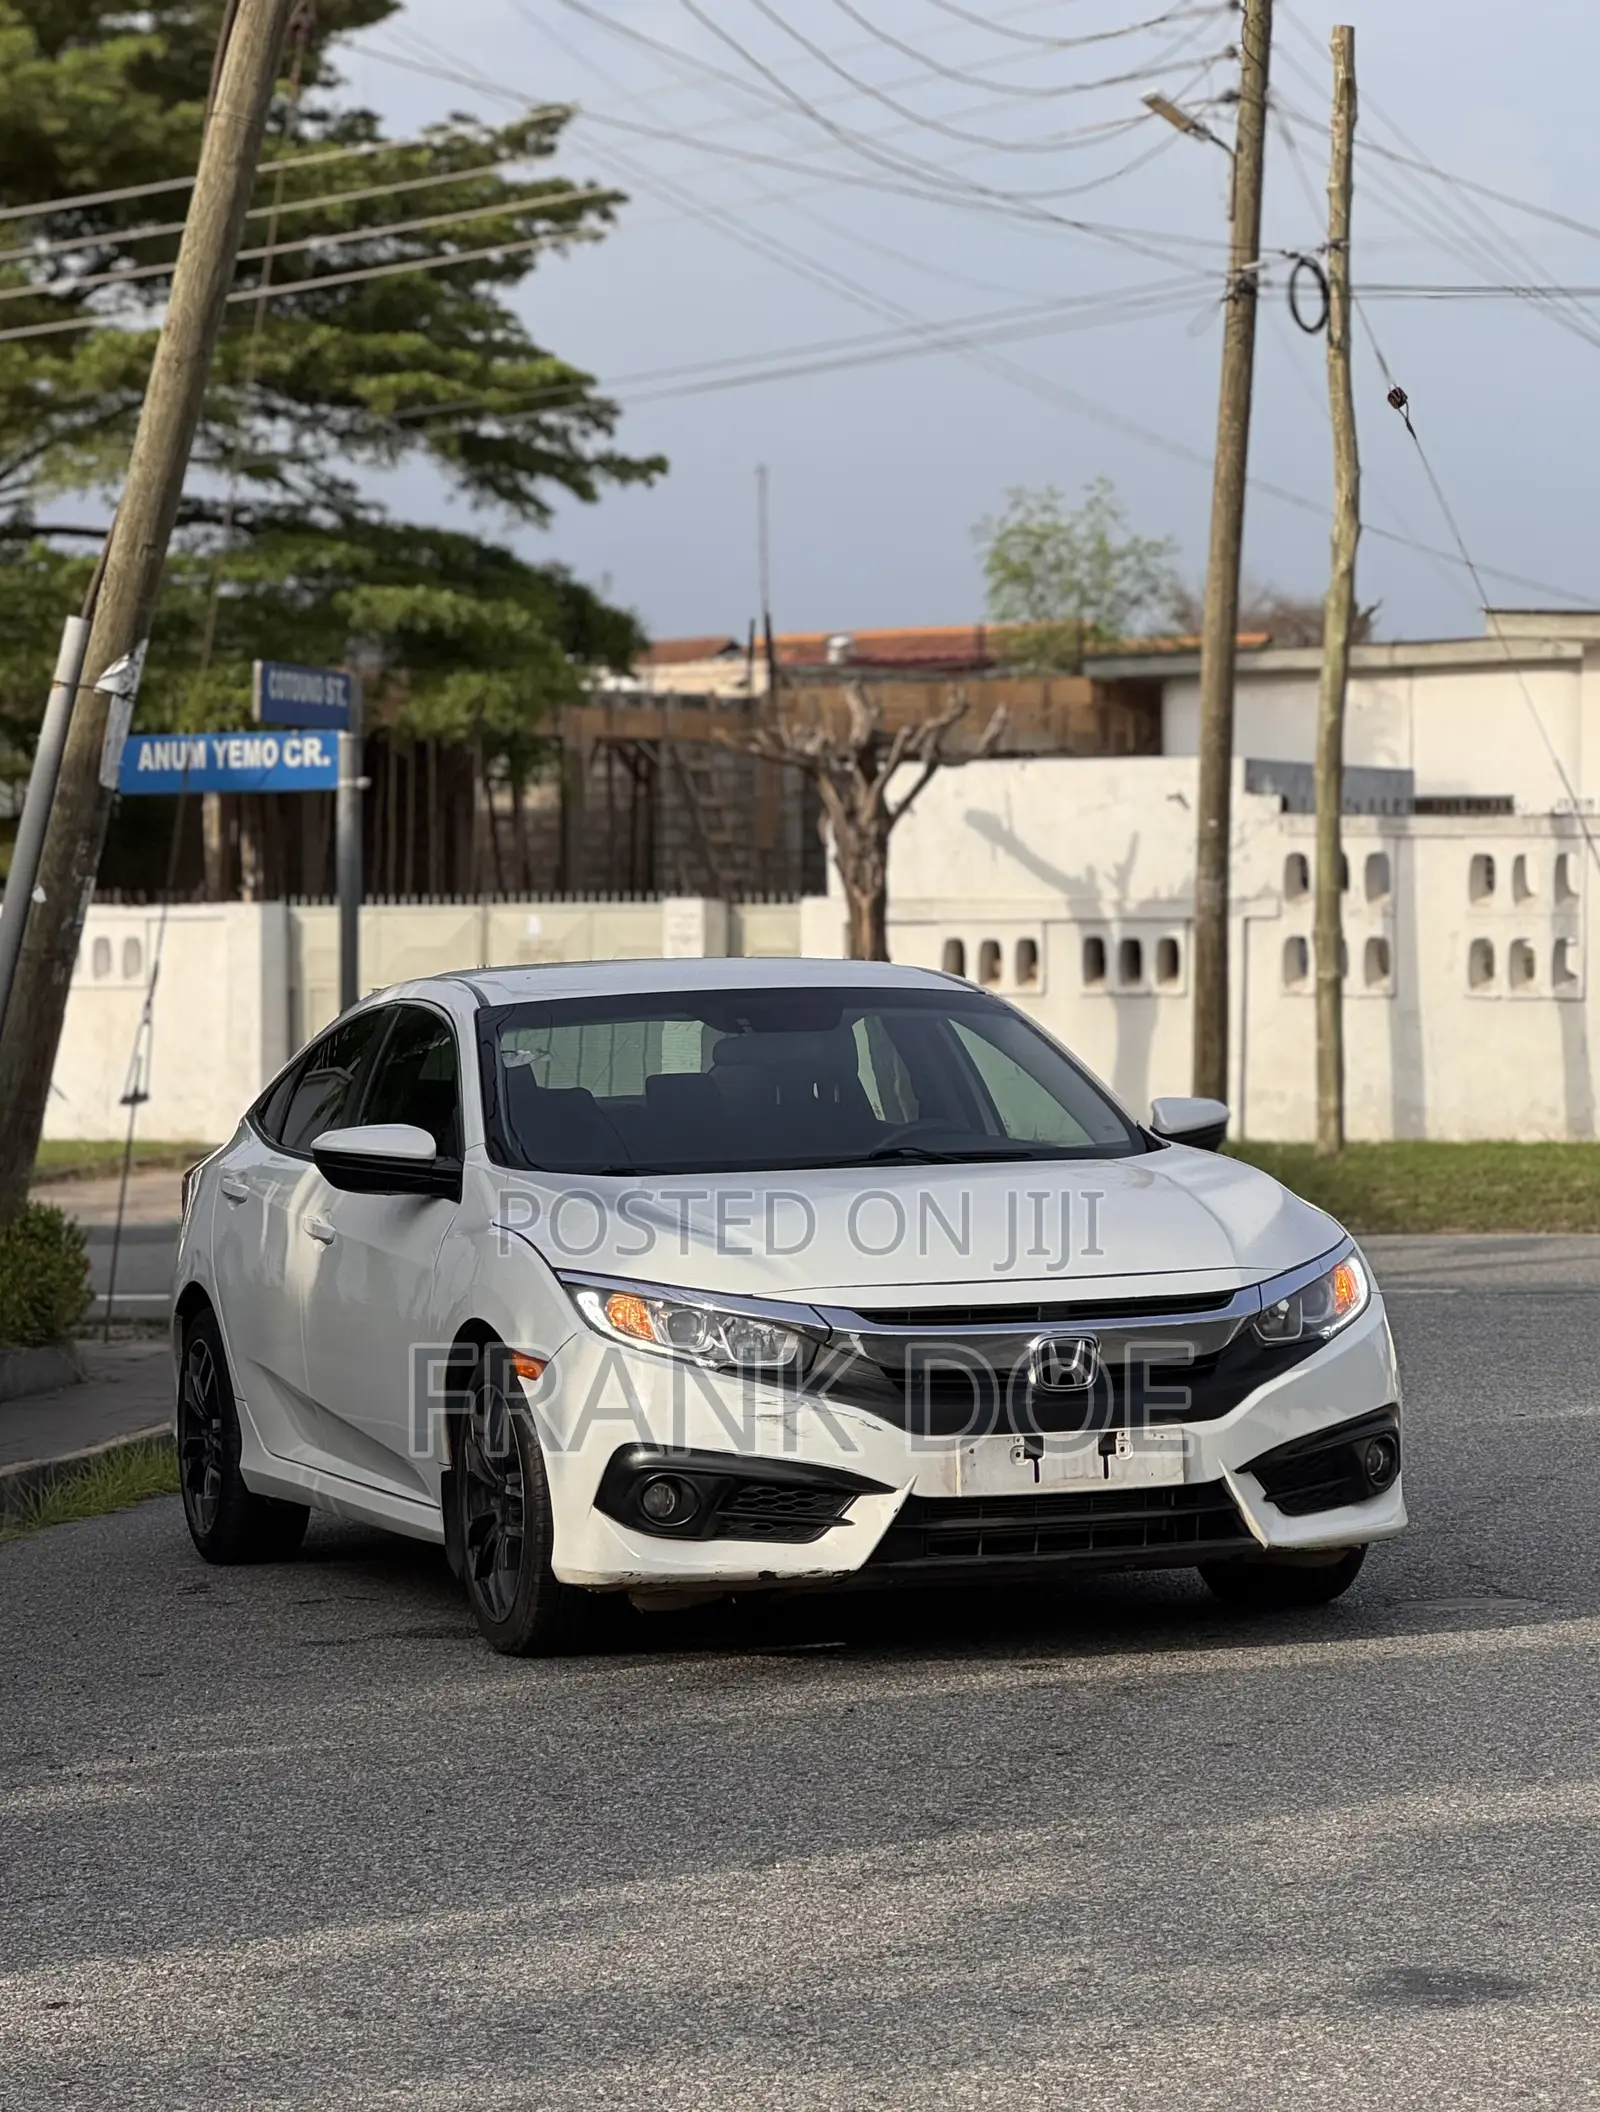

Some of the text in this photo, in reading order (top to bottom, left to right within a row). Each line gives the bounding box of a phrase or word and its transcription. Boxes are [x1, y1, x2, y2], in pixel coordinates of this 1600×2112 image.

[137, 735, 332, 772] ANUM YEMO CR.
